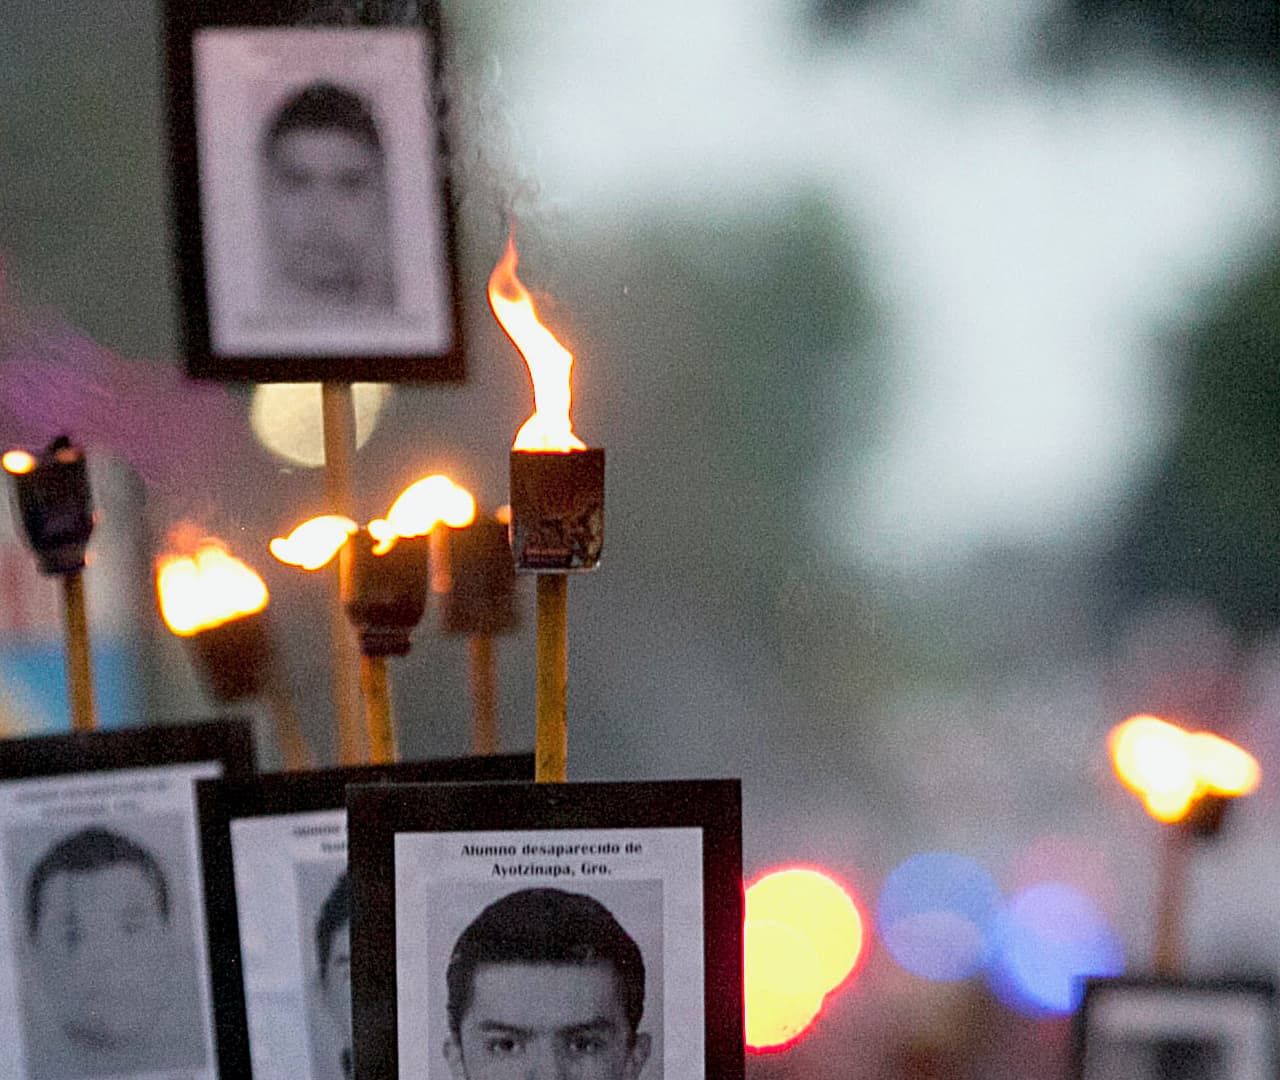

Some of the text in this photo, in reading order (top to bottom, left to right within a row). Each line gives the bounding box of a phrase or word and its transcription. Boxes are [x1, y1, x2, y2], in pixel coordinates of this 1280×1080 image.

[461, 840, 642, 857] Alumno desaparecido de
[492, 860, 612, 878] Ayotzinapa, Gro.
